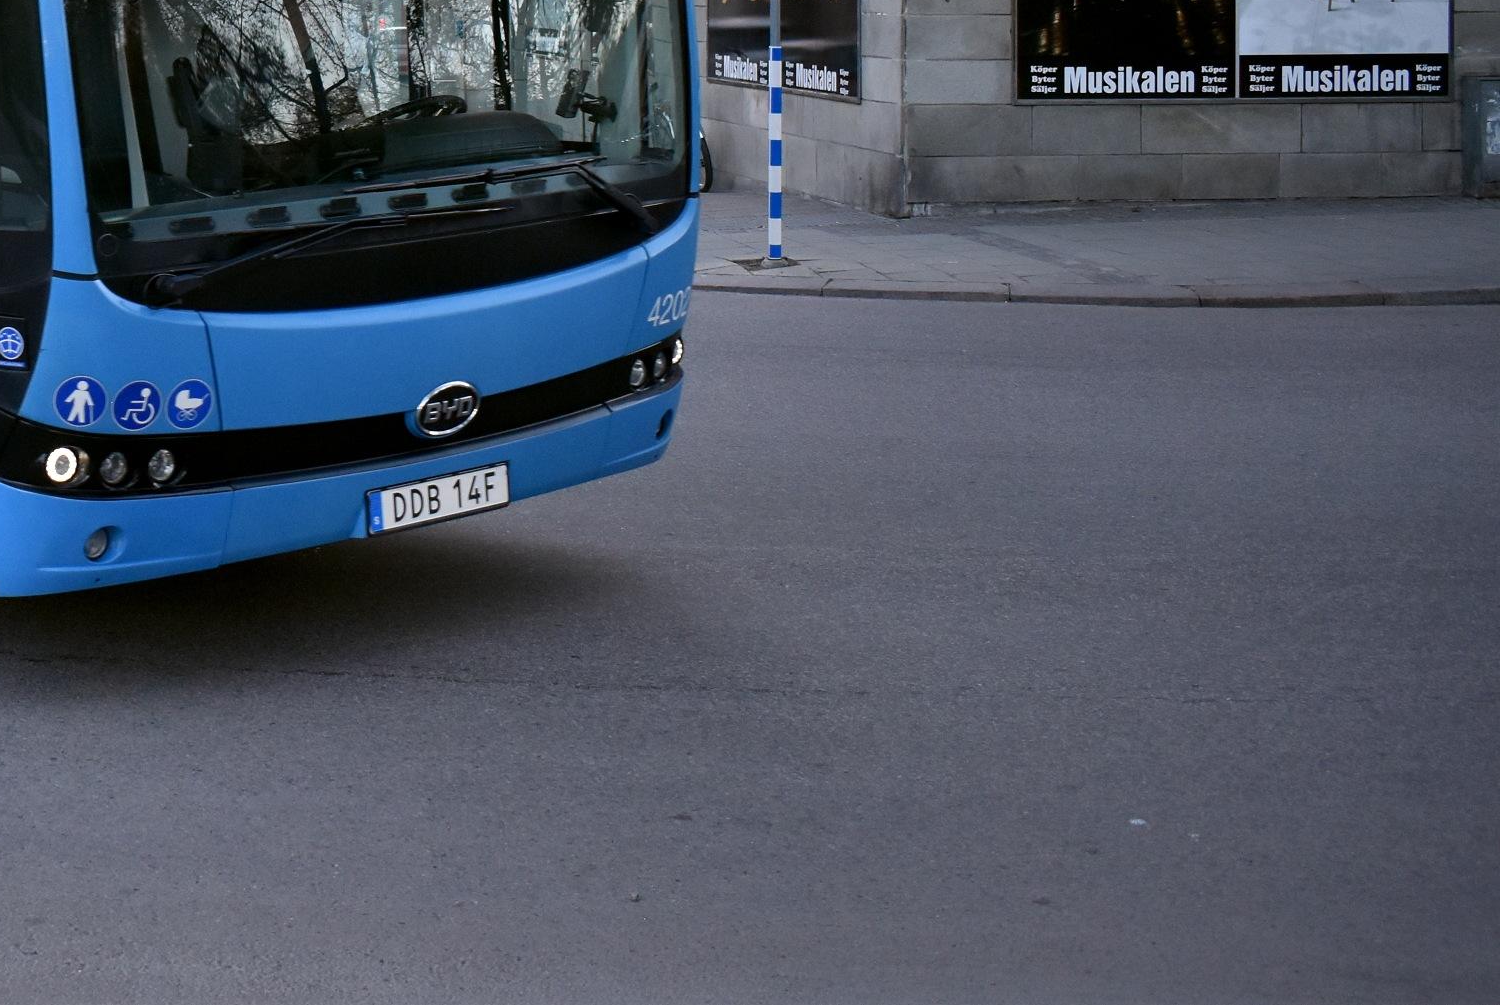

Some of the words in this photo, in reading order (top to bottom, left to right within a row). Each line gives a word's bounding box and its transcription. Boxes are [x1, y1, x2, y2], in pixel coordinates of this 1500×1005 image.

[723, 54, 758, 82] Musikalen
[1030, 65, 1057, 73] Köper
[1201, 65, 1228, 74] Köper
[1248, 64, 1275, 72] Köper
[1415, 64, 1442, 72] Köper
[795, 62, 837, 92] Musikalen
[1031, 75, 1056, 83] Byter
[1063, 66, 1195, 94] Musikalen
[1202, 75, 1226, 84] Byter
[1249, 74, 1274, 83] Byter
[1281, 64, 1410, 93] Musikalen
[1416, 74, 1440, 82] Byter
[1030, 85, 1057, 93] Säljer
[1201, 85, 1227, 93] Säljer
[1249, 84, 1275, 93] Säljer
[1415, 83, 1441, 92] Säljer
[424, 396, 473, 424] BYD
[393, 485, 440, 522] DDB
[453, 471, 495, 508] 14F
[373, 516, 380, 525] S
